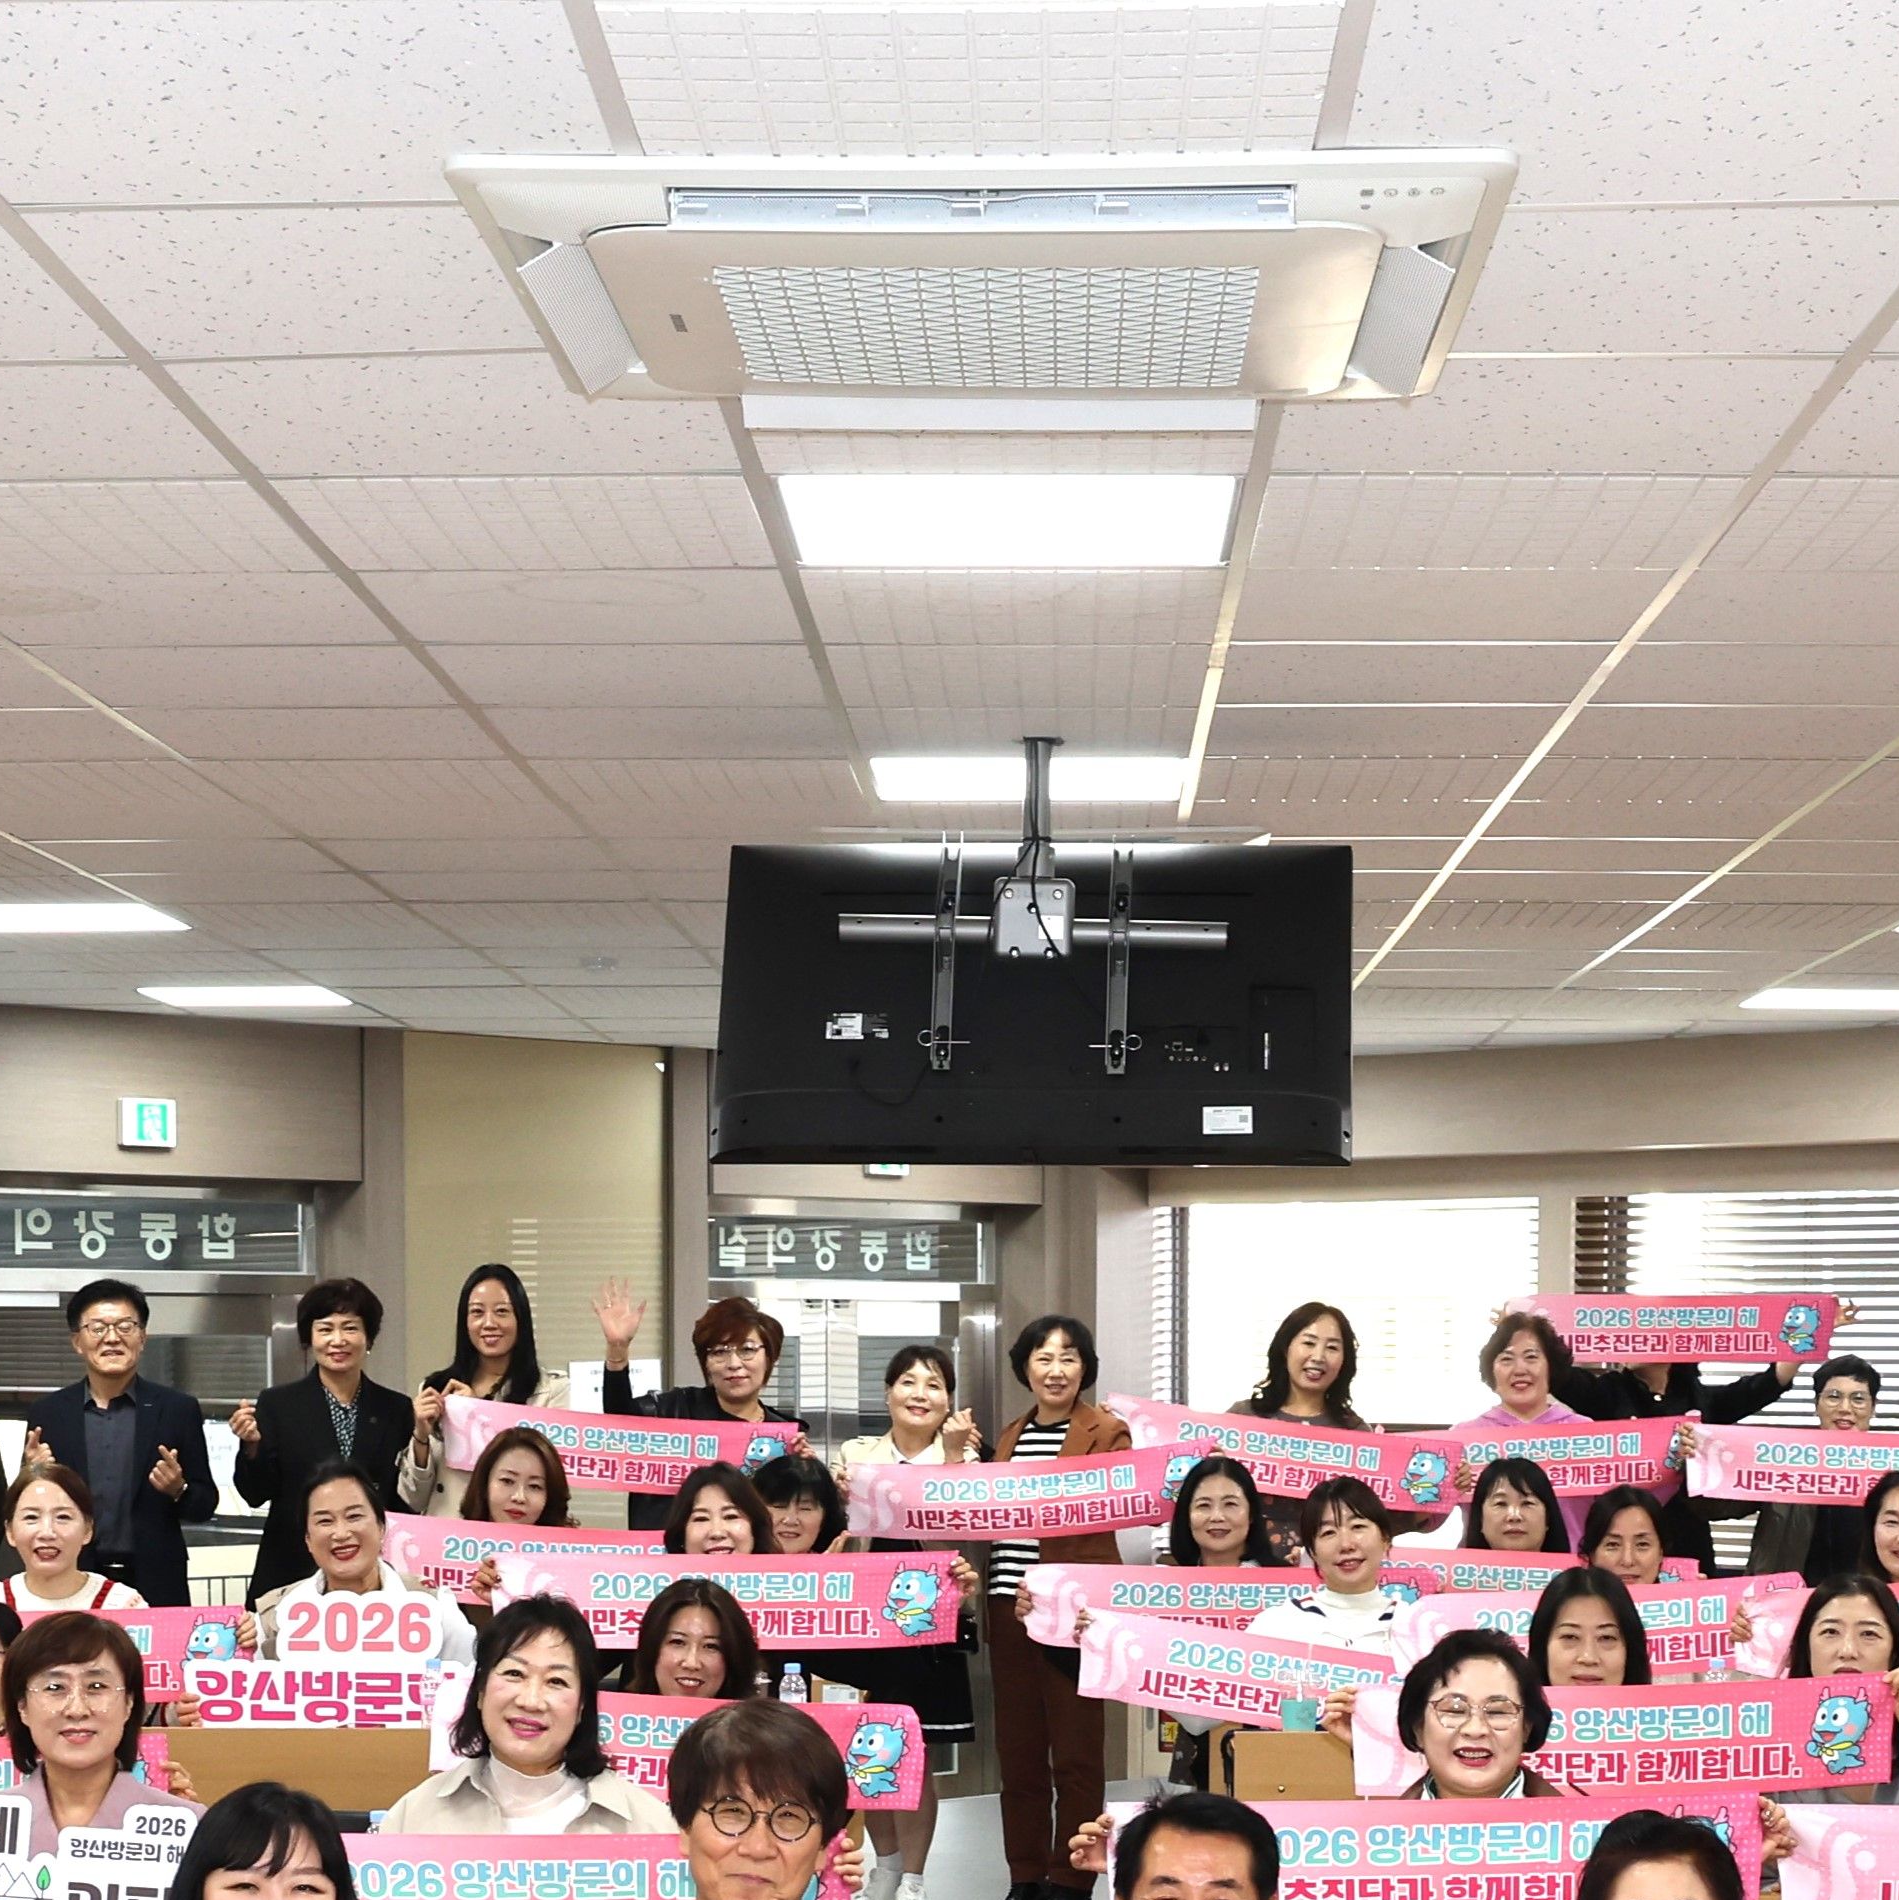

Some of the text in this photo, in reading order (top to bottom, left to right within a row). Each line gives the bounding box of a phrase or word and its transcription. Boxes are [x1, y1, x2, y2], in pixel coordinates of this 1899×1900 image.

[1575, 1307, 1757, 1328] 2026 양산방문의 해
[1673, 1332, 1776, 1353] 함께합니다.
[583, 1428, 717, 1458] 양산방문의 해
[1245, 1431, 1379, 1469] 양산방문의 해
[1504, 1434, 1639, 1463] 양산방문의 해
[1756, 1443, 1820, 1467] 2026
[924, 1467, 1134, 1502] 2026 양산방문의 해
[1549, 1460, 1661, 1488] 함께합니다.
[1733, 1470, 1860, 1495] 시민추진단과
[904, 1494, 1160, 1532] 시민추진단과 함께합니다.
[592, 1573, 853, 1601] 2026 해
[1112, 1584, 1183, 1607] 2026
[1700, 1596, 1726, 1626] 해
[287, 1602, 431, 1653] 2026
[1168, 1641, 1242, 1671] 2026
[1573, 1702, 1772, 1739] 양산방문의 해
[1638, 1749, 1801, 1783] 함께합니다.
[136, 1816, 186, 1837] 2026
[70, 1839, 185, 1863] 양산방문의 해
[1368, 1823, 1559, 1863] 양산방문의
[455, 1860, 646, 1898] 양산방문의
